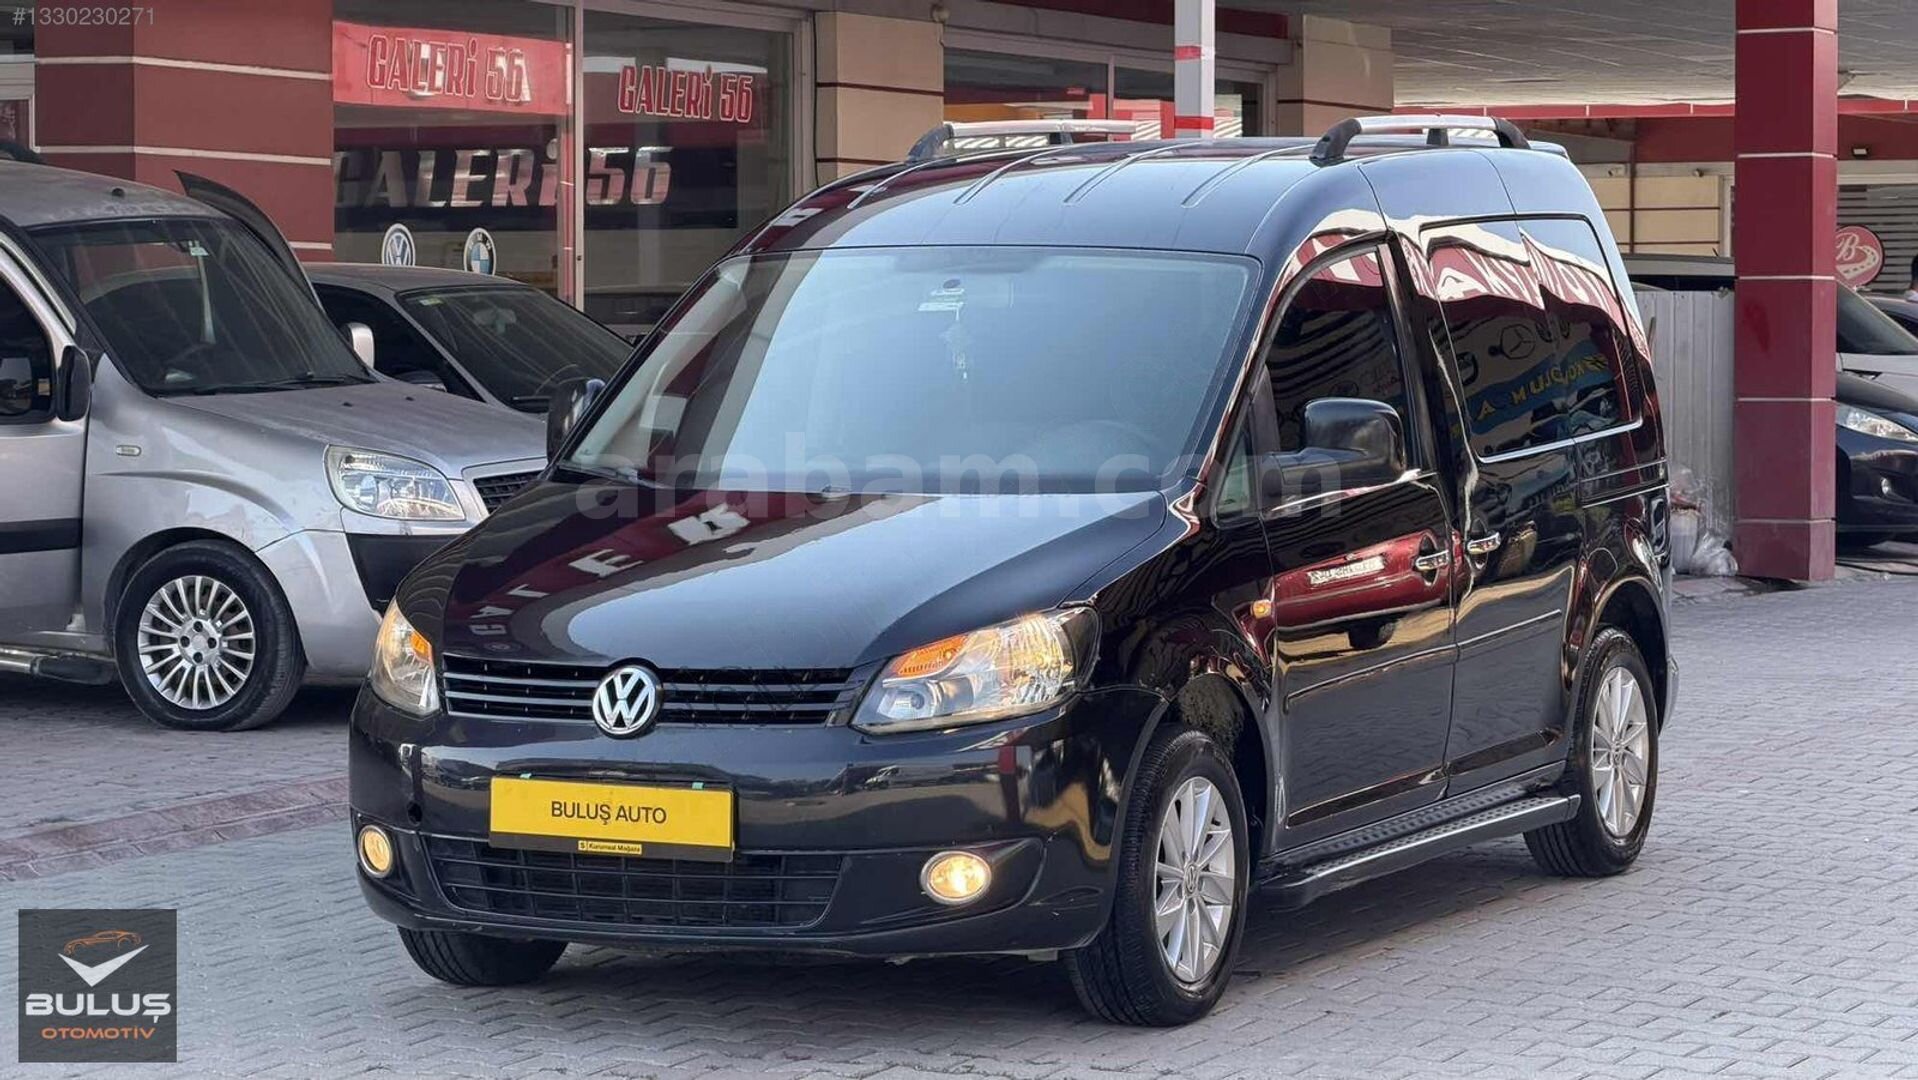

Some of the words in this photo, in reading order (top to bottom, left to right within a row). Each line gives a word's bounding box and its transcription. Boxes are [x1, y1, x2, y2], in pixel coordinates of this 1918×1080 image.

[485, 46, 525, 102] 56
[719, 72, 754, 123] 56
[585, 146, 674, 205] 56
[550, 800, 611, 825] BULUŞ
[615, 804, 668, 824] AUTO
